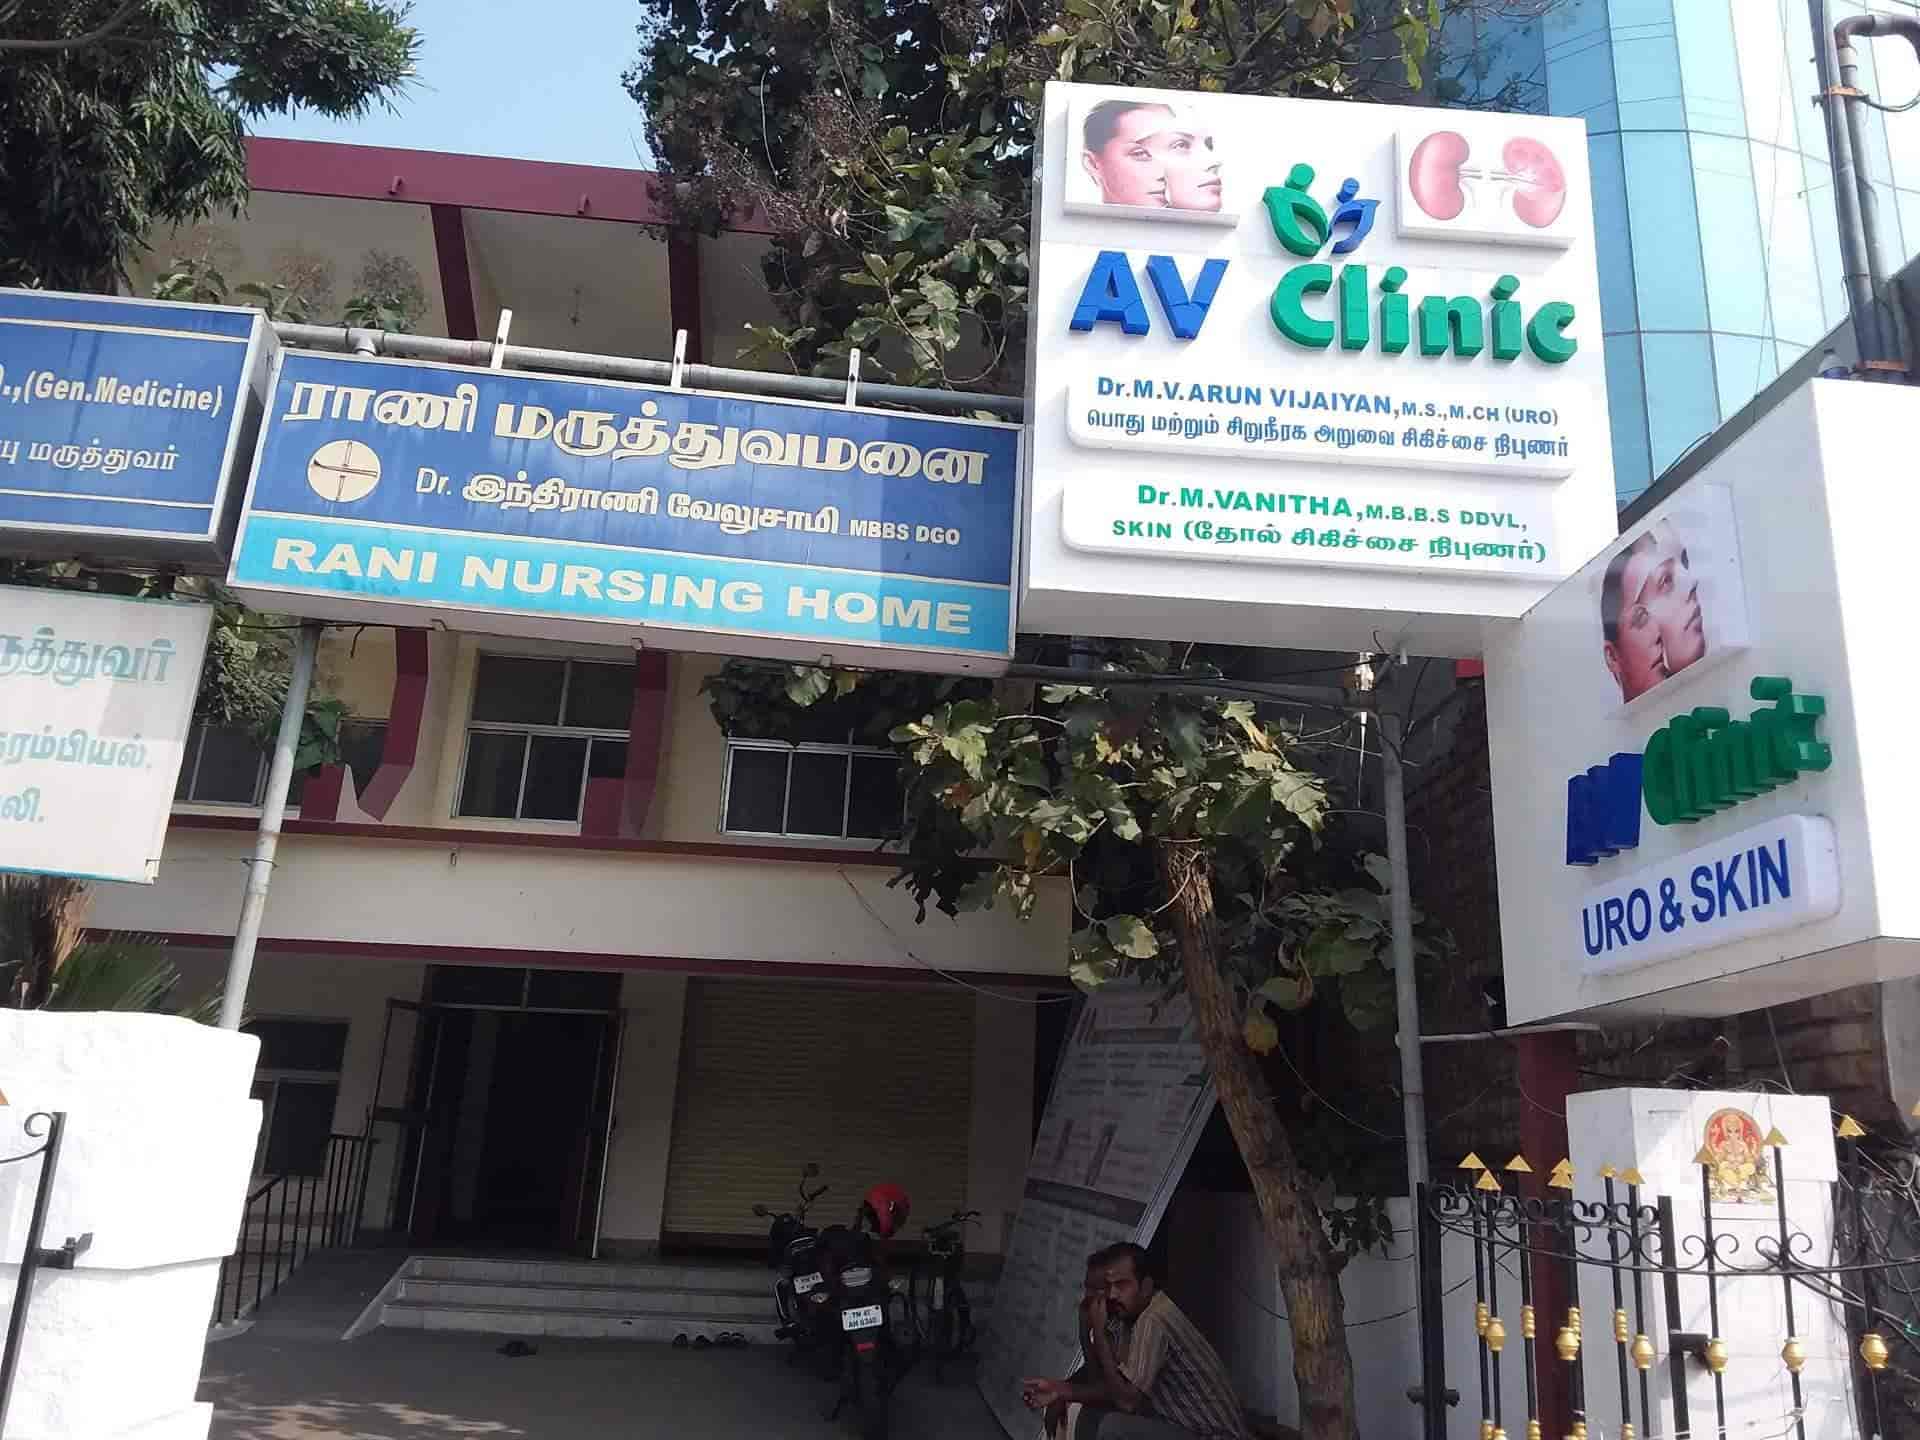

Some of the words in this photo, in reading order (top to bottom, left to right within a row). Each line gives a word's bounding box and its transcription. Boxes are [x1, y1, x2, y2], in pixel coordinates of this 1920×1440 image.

[1069, 250, 1229, 339] AV
[1271, 263, 1578, 364] Clinic
[282, 382, 479, 433] ராணி
[494, 400, 991, 485] மருத்துவமனை
[1088, 409, 1145, 436] பொது
[1152, 411, 1220, 439] மற்றும்
[1227, 415, 1308, 443] சிறுநீரக
[1315, 424, 1395, 449] அறுவை
[1402, 427, 1488, 451] சிகிச்சை
[1495, 433, 1569, 459] நிபுணர்
[1505, 405, 1558, 426] (URO)
[28, 438, 179, 474] மருத்துவர்
[416, 467, 452, 496] Dr.
[463, 471, 660, 514] இந்திராணி
[668, 492, 839, 534] வேலுசாமி
[850, 519, 909, 541] MBBS
[915, 525, 960, 546] DGO
[1112, 520, 1172, 538] SKIN
[1184, 520, 1281, 544] (தோல்
[1291, 527, 1418, 552] சிகிச்சை
[1460, 510, 1528, 532] DDVL,
[272, 538, 438, 584] RANI
[462, 555, 764, 612] NURSING
[786, 585, 973, 635] HOME
[1581, 887, 1652, 956] URO
[1659, 877, 1685, 933] &
[1690, 838, 1792, 922] SKIN
